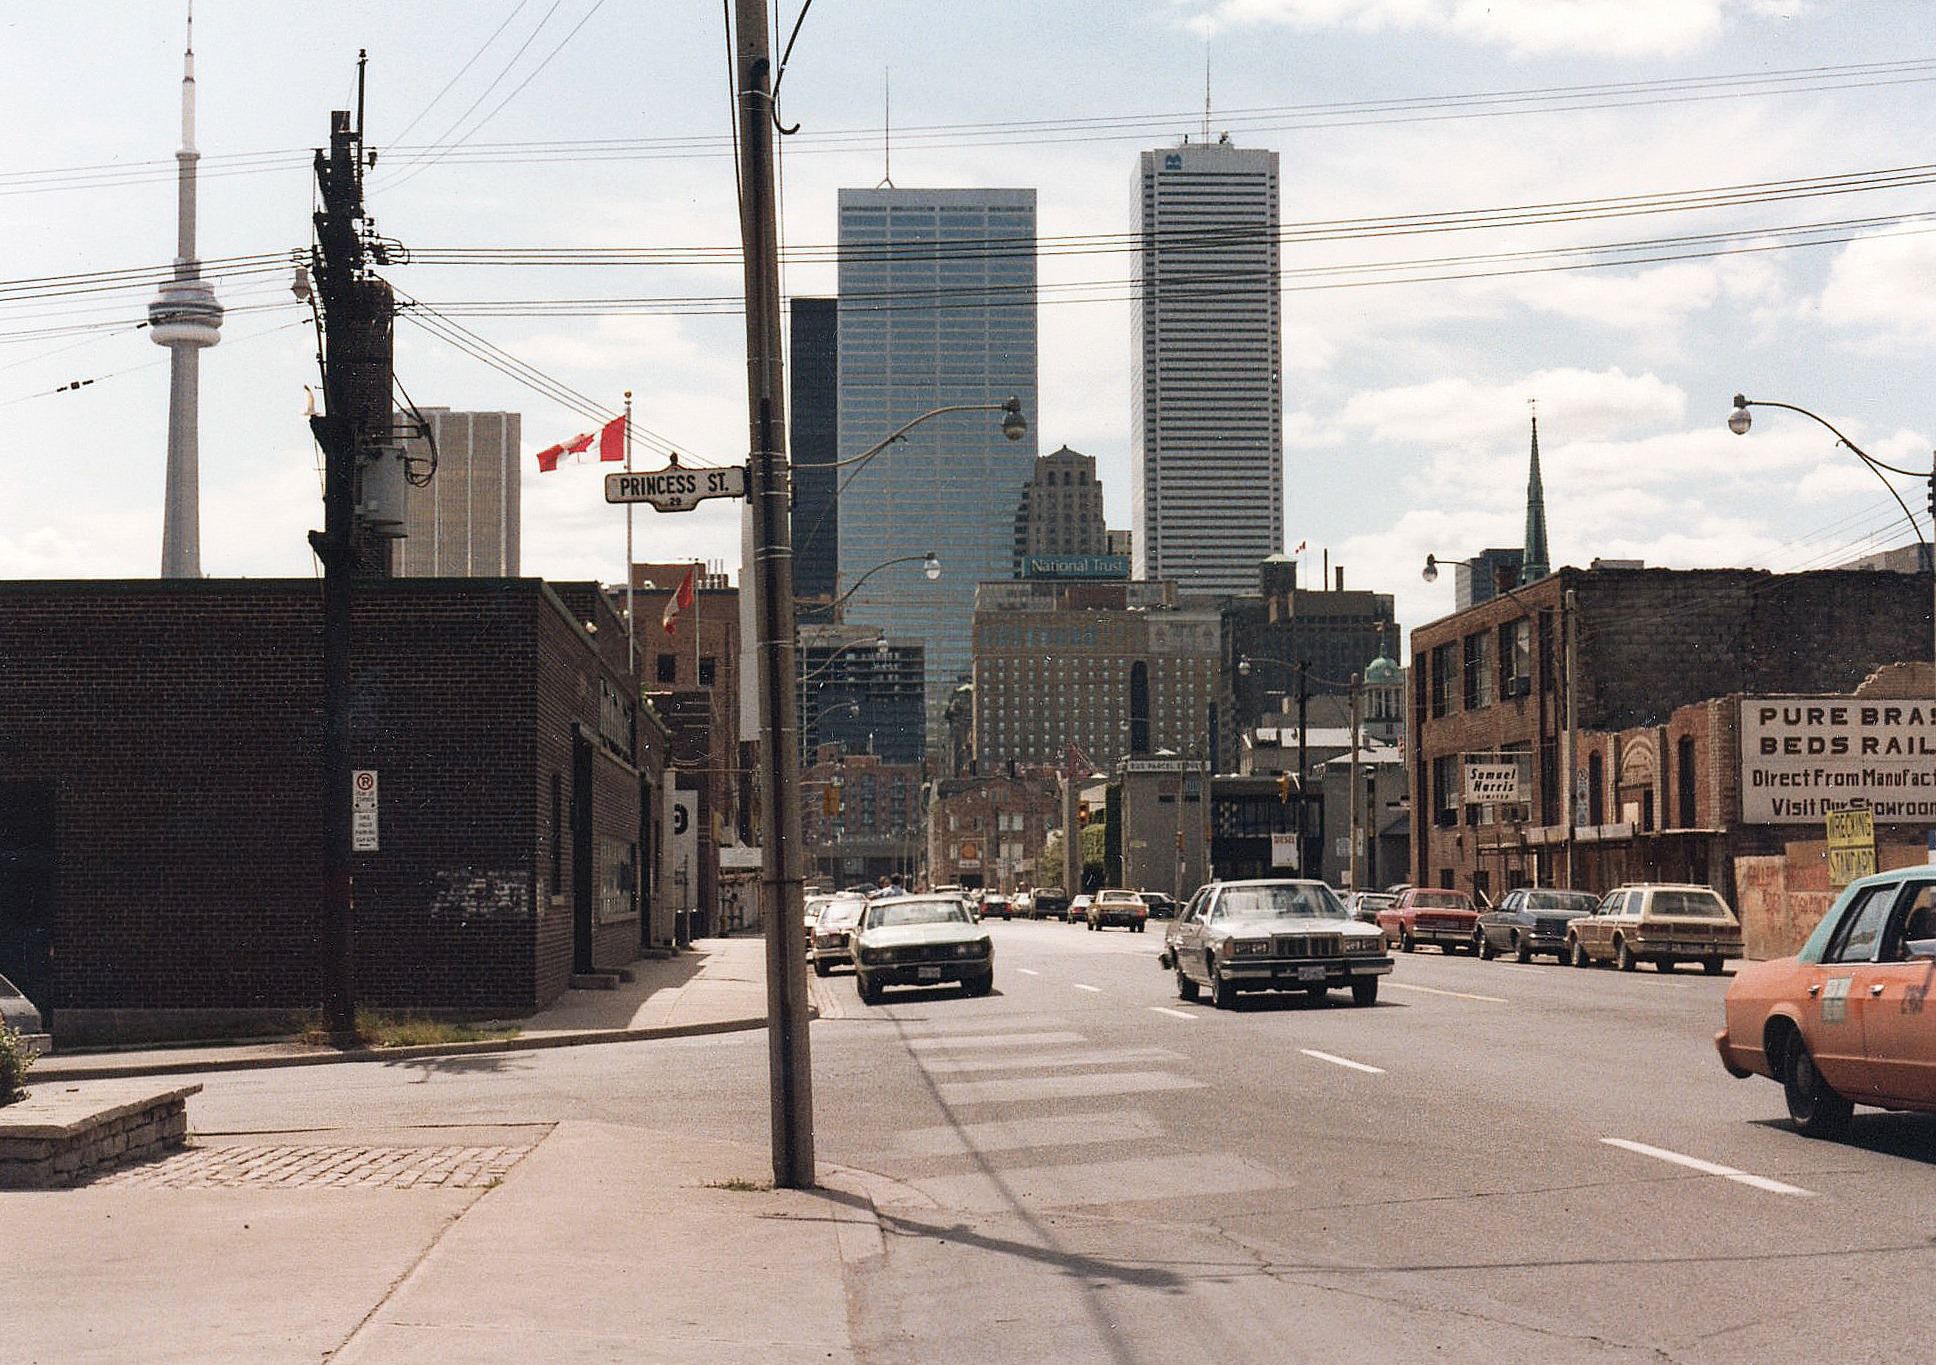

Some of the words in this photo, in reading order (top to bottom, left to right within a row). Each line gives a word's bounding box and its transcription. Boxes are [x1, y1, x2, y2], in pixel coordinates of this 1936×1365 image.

[620, 475, 696, 496] PRINCESS
[707, 473, 729, 492] ST.
[1031, 558, 1088, 573] National
[1094, 558, 1123, 573] Trust
[1759, 707, 1849, 726] PURE
[1760, 736, 1850, 755] BEDS
[1861, 736, 1936, 755] RAIL
[1470, 768, 1516, 780] Samuel
[1753, 769, 1810, 787] Direct
[1814, 769, 1860, 787] From
[1473, 780, 1514, 792] Harris
[1772, 798, 1816, 816] Visit
